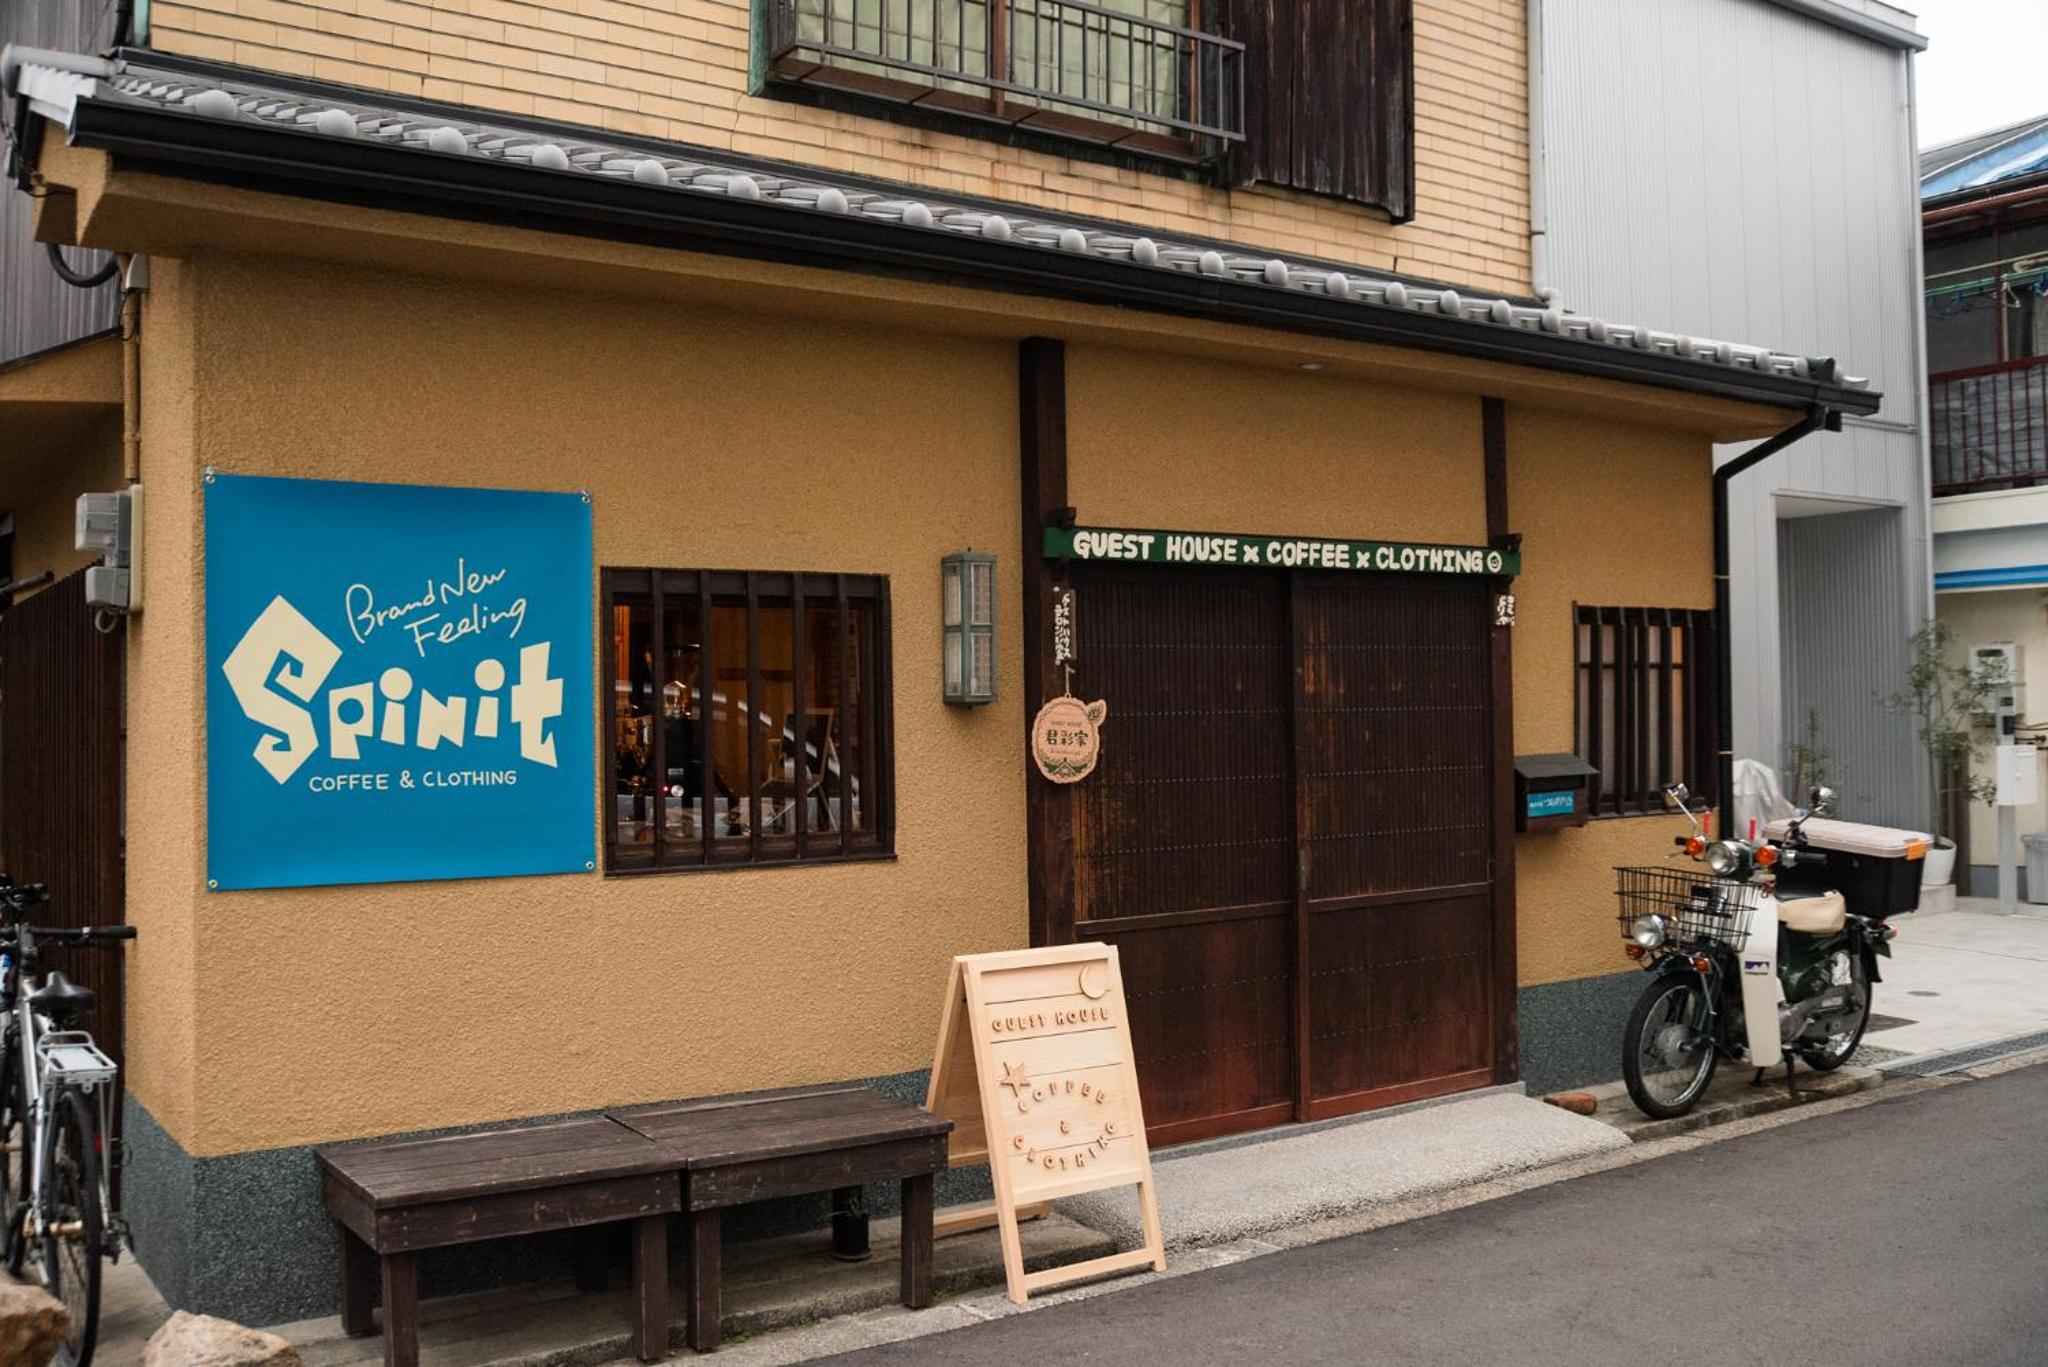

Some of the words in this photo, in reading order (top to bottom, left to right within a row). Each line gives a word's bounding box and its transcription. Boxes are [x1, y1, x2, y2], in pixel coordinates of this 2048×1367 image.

[1073, 531, 1155, 559] GUEST
[1166, 536, 1238, 562] HOUSE
[1266, 541, 1350, 567] COFFEE
[1375, 547, 1484, 573] CLOTHING
[345, 579, 436, 644] Brand
[440, 557, 506, 605] New
[404, 597, 527, 658] Feeling
[308, 772, 390, 793] COFFEE
[399, 770, 415, 789] &
[422, 769, 518, 788] CLOTHING
[992, 1013, 1046, 1033] GUEST
[1056, 1007, 1109, 1026] HOUSE
[1018, 1080, 1107, 1113] COFFEE
[1013, 1120, 1117, 1171] CLOTHING
